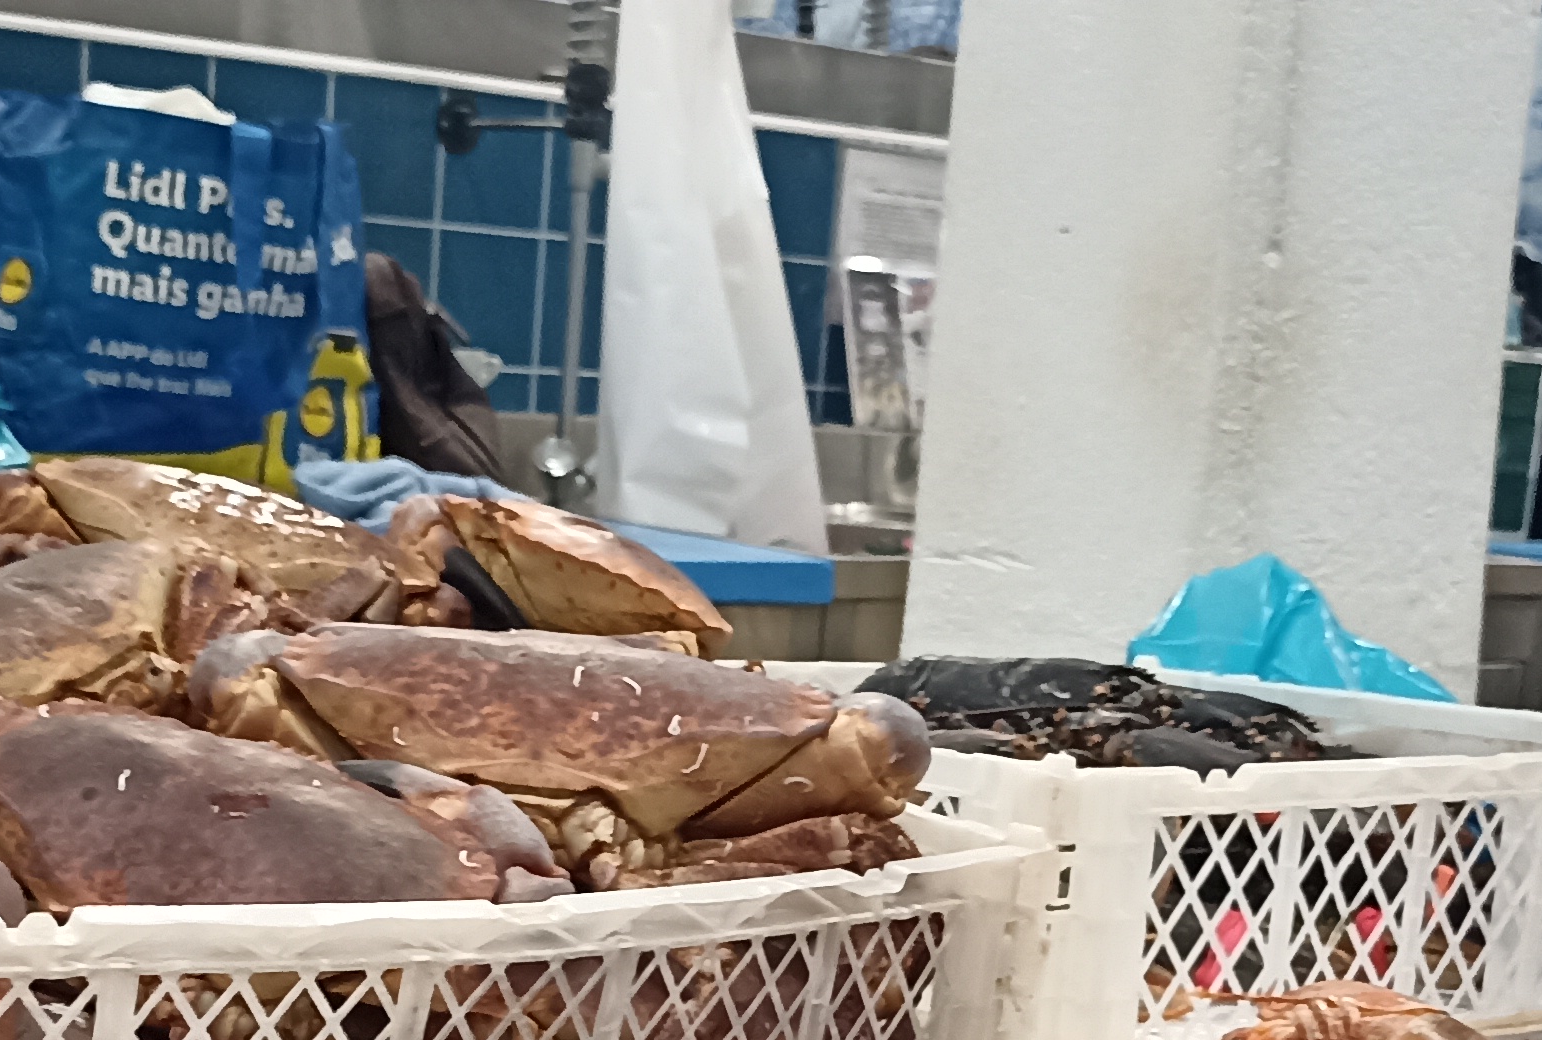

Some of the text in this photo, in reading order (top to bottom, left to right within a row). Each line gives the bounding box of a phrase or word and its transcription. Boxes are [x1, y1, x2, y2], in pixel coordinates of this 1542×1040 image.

[104, 159, 294, 229] Lidl Ps.
[91, 263, 306, 320] mais ganha
